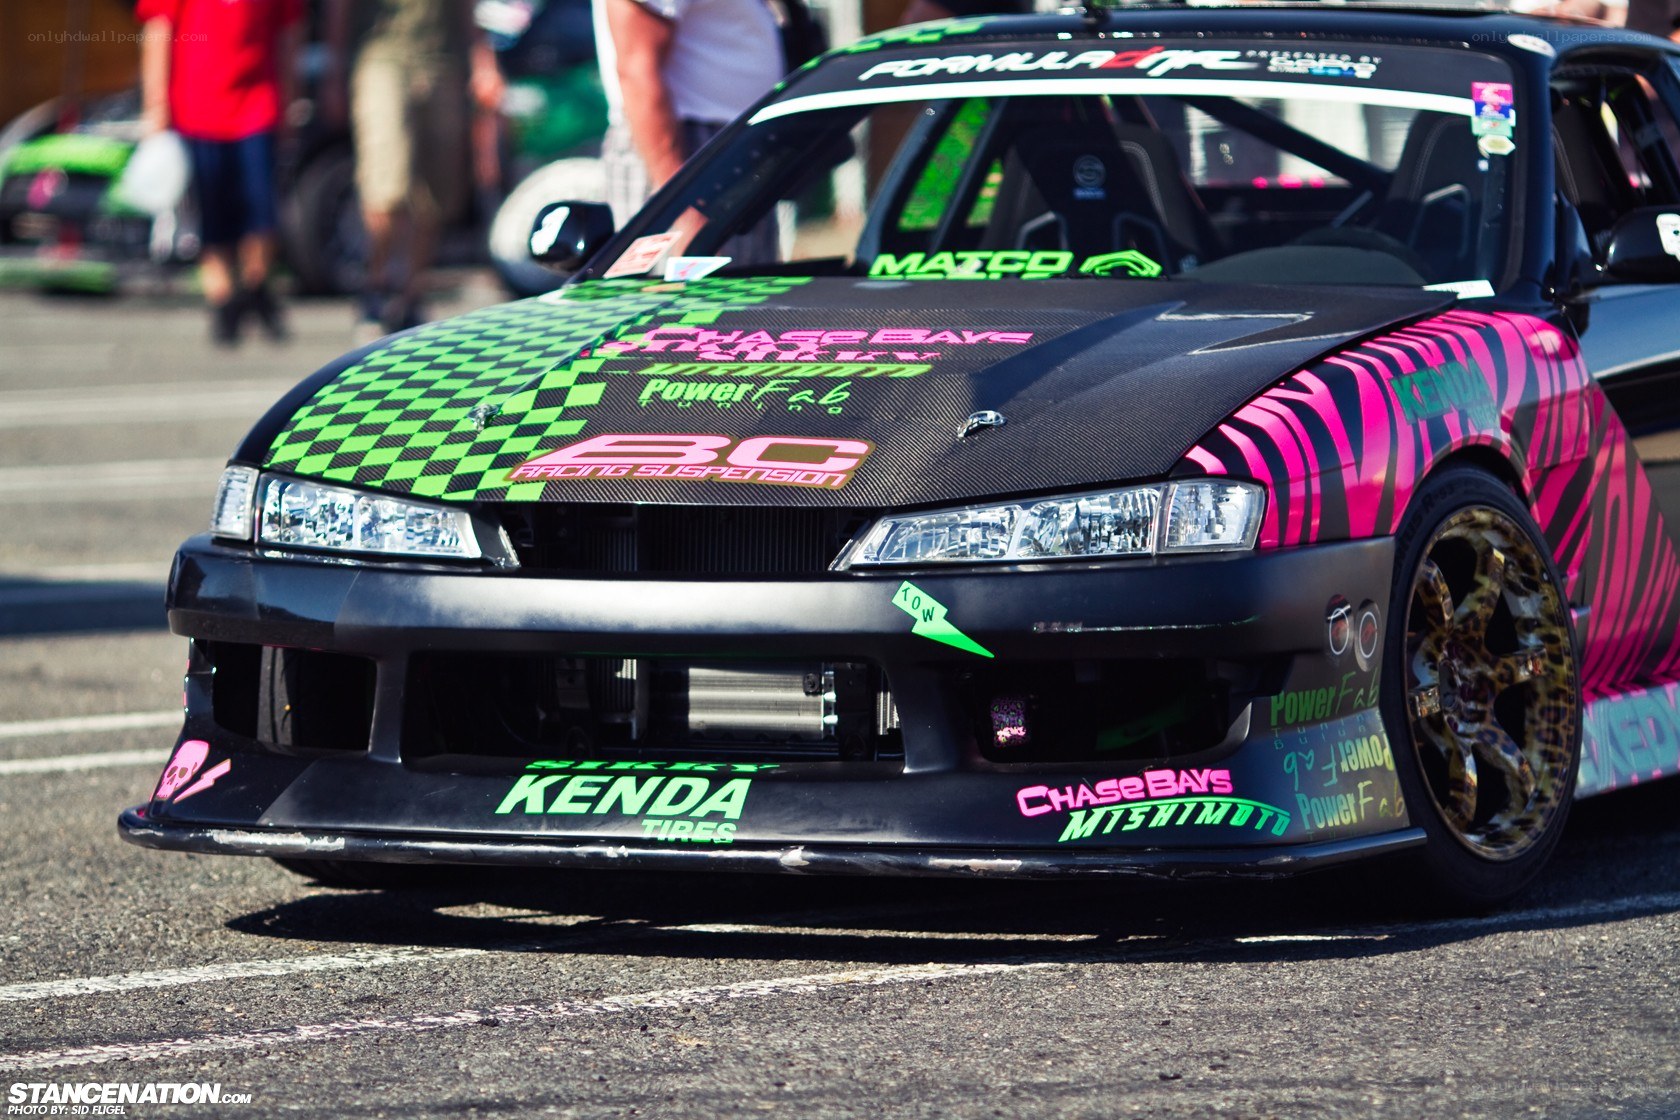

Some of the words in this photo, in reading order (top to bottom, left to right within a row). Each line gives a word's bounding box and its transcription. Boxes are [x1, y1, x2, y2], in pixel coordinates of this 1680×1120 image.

[868, 250, 1074, 277] MATCO
[1390, 357, 1494, 423] KENDA
[523, 433, 869, 472] BC
[510, 463, 633, 479] RACING
[636, 464, 847, 487] SUSPENSION
[902, 586, 935, 622] TOW
[495, 774, 752, 820] KENDA
[640, 818, 739, 844] TIRES
[1058, 799, 1291, 843] MISHIMOTO
